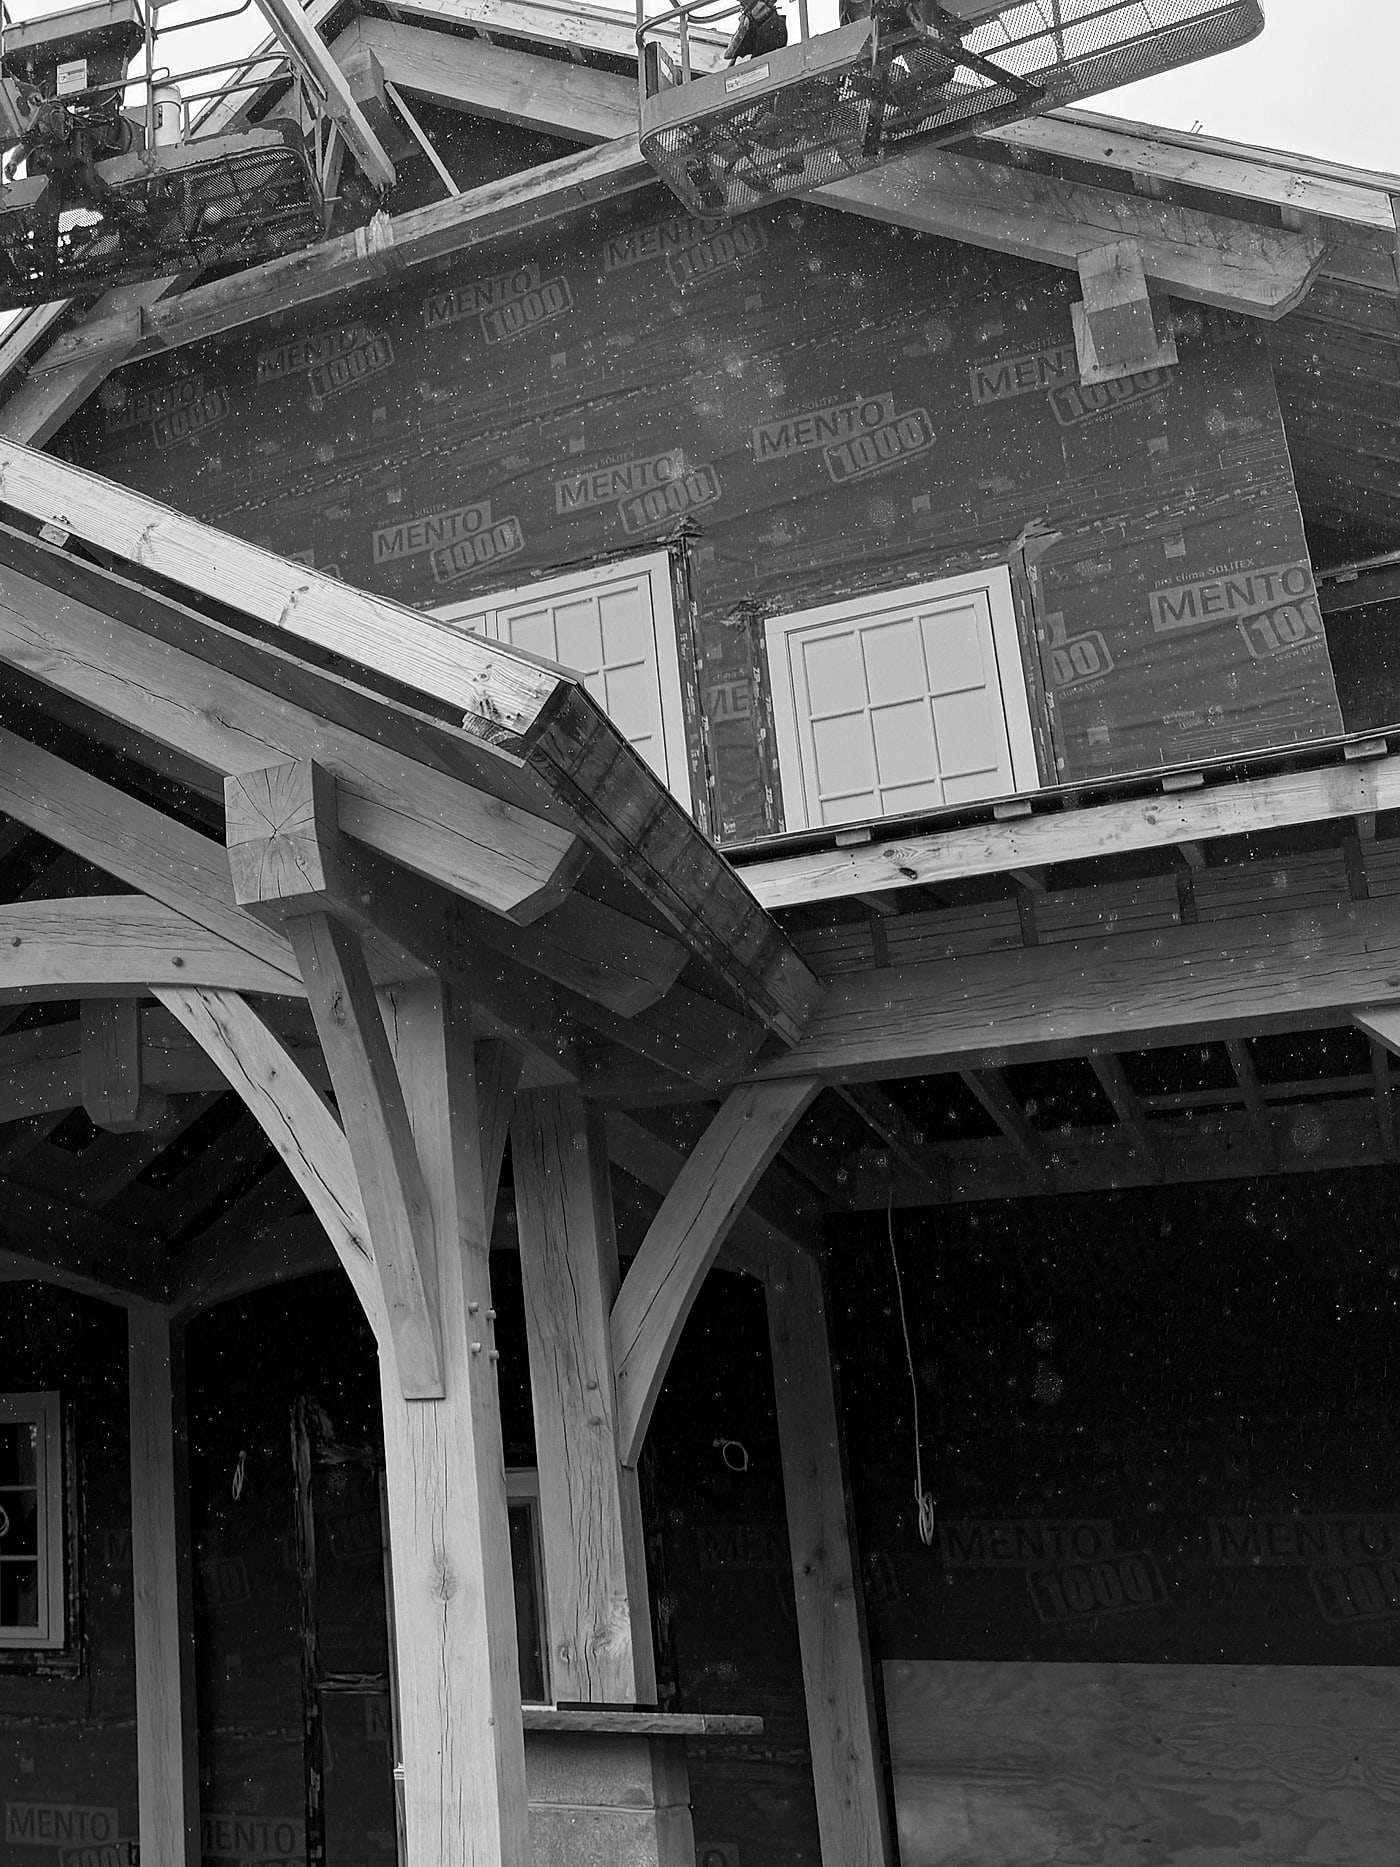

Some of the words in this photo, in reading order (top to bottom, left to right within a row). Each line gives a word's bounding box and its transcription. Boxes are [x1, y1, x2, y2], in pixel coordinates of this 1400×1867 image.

[677, 224, 758, 279] 1000
[429, 270, 531, 323] MENTO
[486, 284, 564, 336] 1000
[262, 330, 358, 377] MENTO
[316, 341, 386, 391] 1000
[109, 382, 195, 427] MENTO
[159, 394, 220, 441] 1000
[760, 402, 884, 455] MENTO
[832, 417, 924, 474] 1000
[561, 457, 674, 507] MENTO
[628, 472, 711, 526] 1000
[379, 509, 482, 557] MENTO
[439, 523, 514, 580] 1000
[1154, 574, 1172, 589] pro
[1176, 570, 1205, 582] clima
[1208, 558, 1255, 576] SOLITEX
[1157, 566, 1312, 624] MENTO
[946, 1525, 1100, 1559] MENTO
[1217, 1521, 1390, 1557] MENTO
[1039, 1559, 1154, 1614] 1000
[10, 1807, 110, 1841] MENTO
